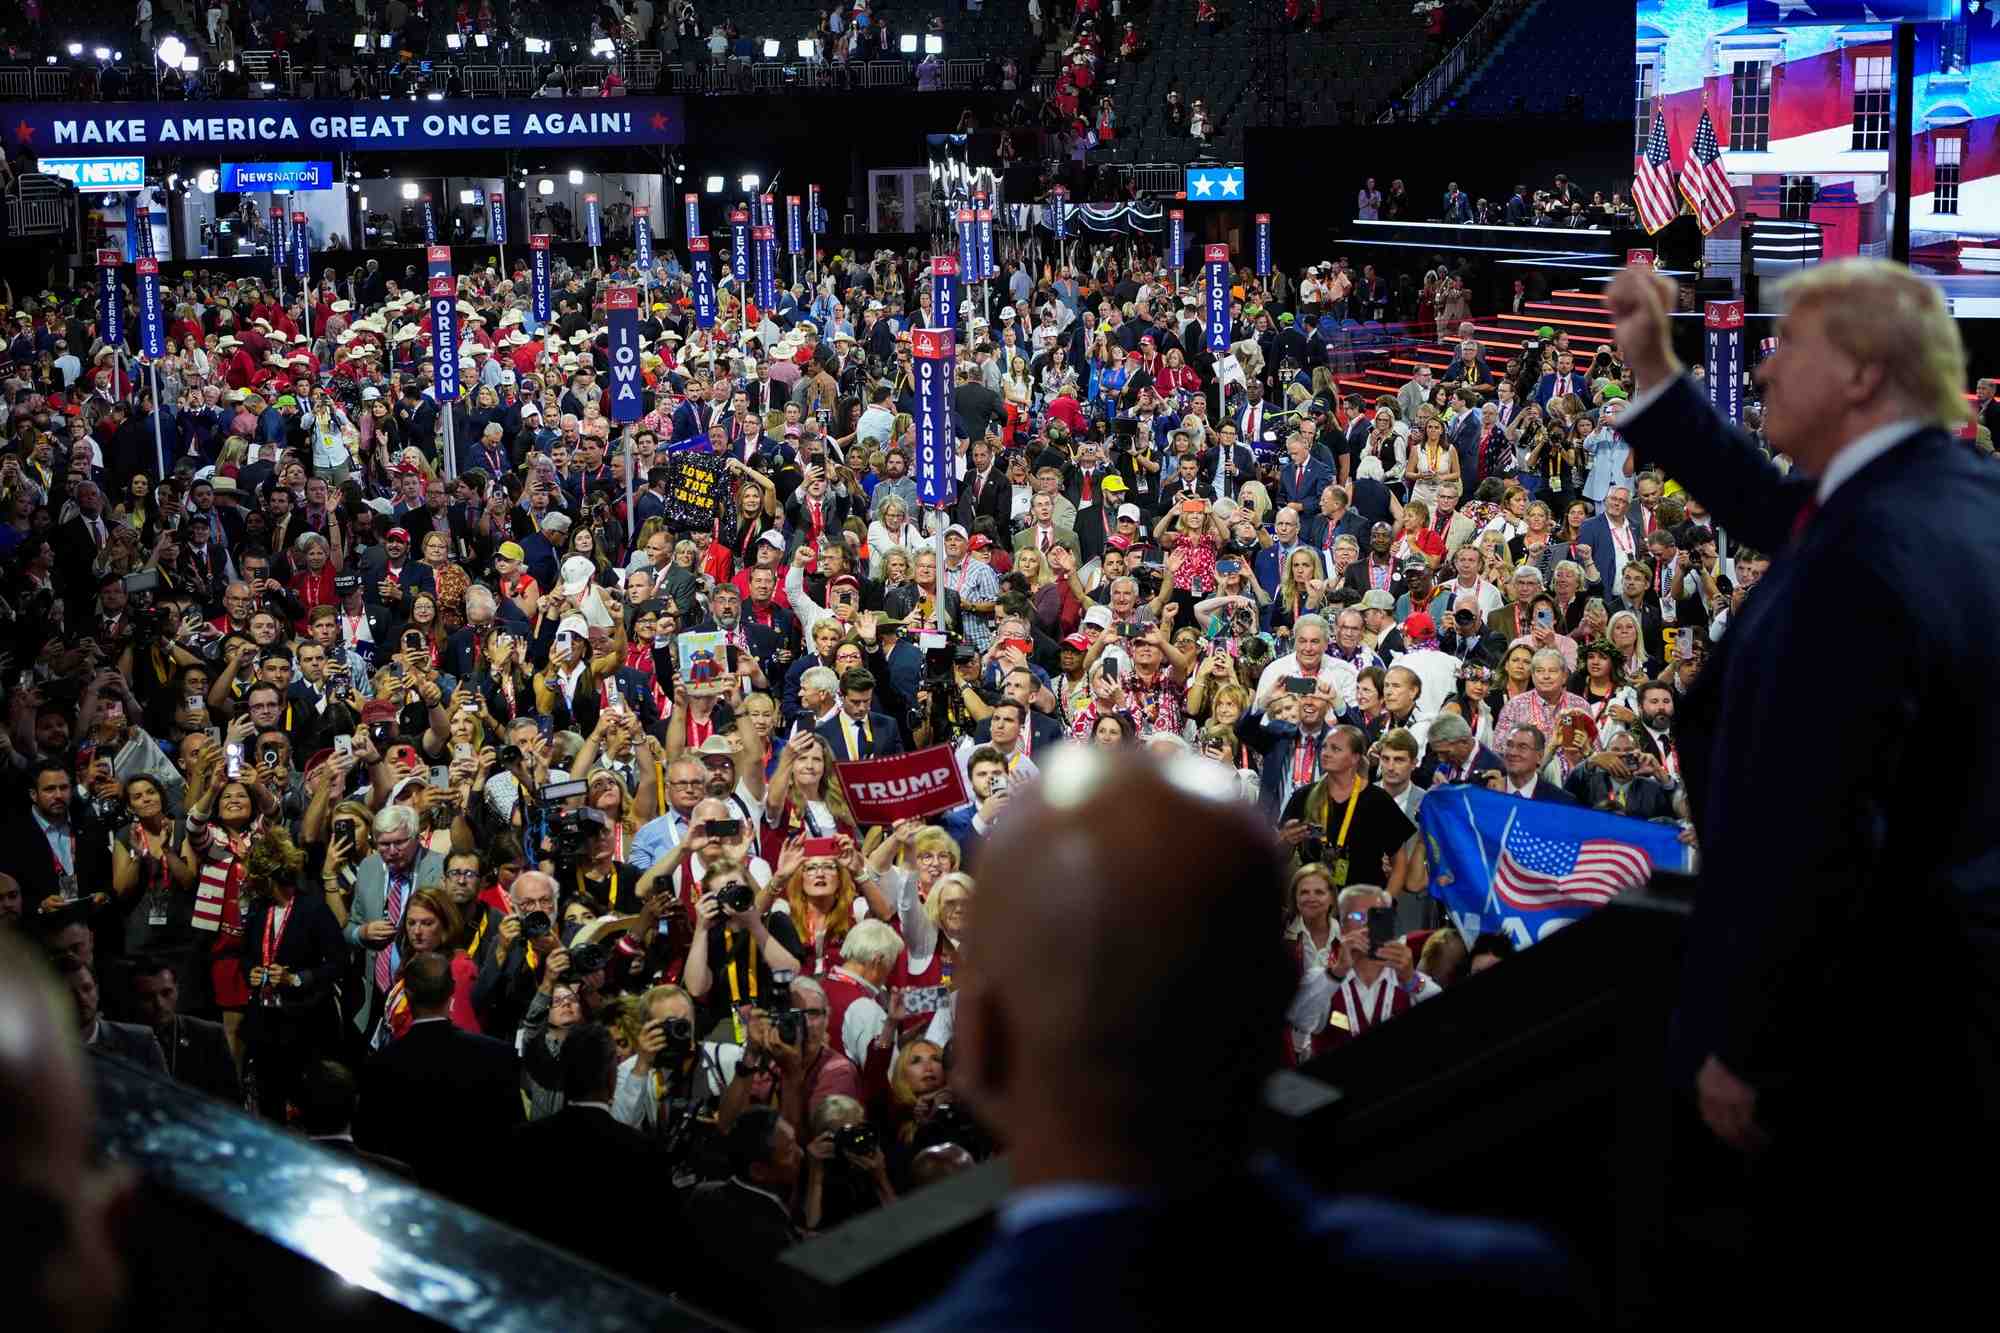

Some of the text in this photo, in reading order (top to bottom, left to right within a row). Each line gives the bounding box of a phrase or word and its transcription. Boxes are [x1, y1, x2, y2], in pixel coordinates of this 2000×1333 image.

[54, 112, 631, 143] MAKE AMERICA GREAT ONCE AGAIN!
[82, 161, 140, 182] NEWS
[424, 202, 433, 239] KANSAS
[493, 202, 503, 241] MONTANA
[639, 217, 649, 266] ALABAMA
[736, 225, 746, 275] TEXAS
[982, 222, 991, 276] NEW YORK
[107, 268, 117, 341] NEW JERSEY
[536, 250, 546, 318] KENTUCKY
[695, 261, 709, 316] MAINE
[941, 278, 950, 326] INDI
[1212, 264, 1224, 346] FLORIDA
[145, 276, 158, 354] PUERTO RICO
[436, 300, 453, 394] OREGON
[614, 328, 637, 400] IOWA
[1710, 332, 1718, 407] MINNE
[1729, 332, 1738, 426] MINNESO
[920, 362, 935, 496] OKLAHOMA
[943, 362, 953, 495] OKLAHOMA
[682, 463, 714, 483] IOWA
[684, 478, 709, 494] FOR
[850, 767, 950, 799] TRUMP
